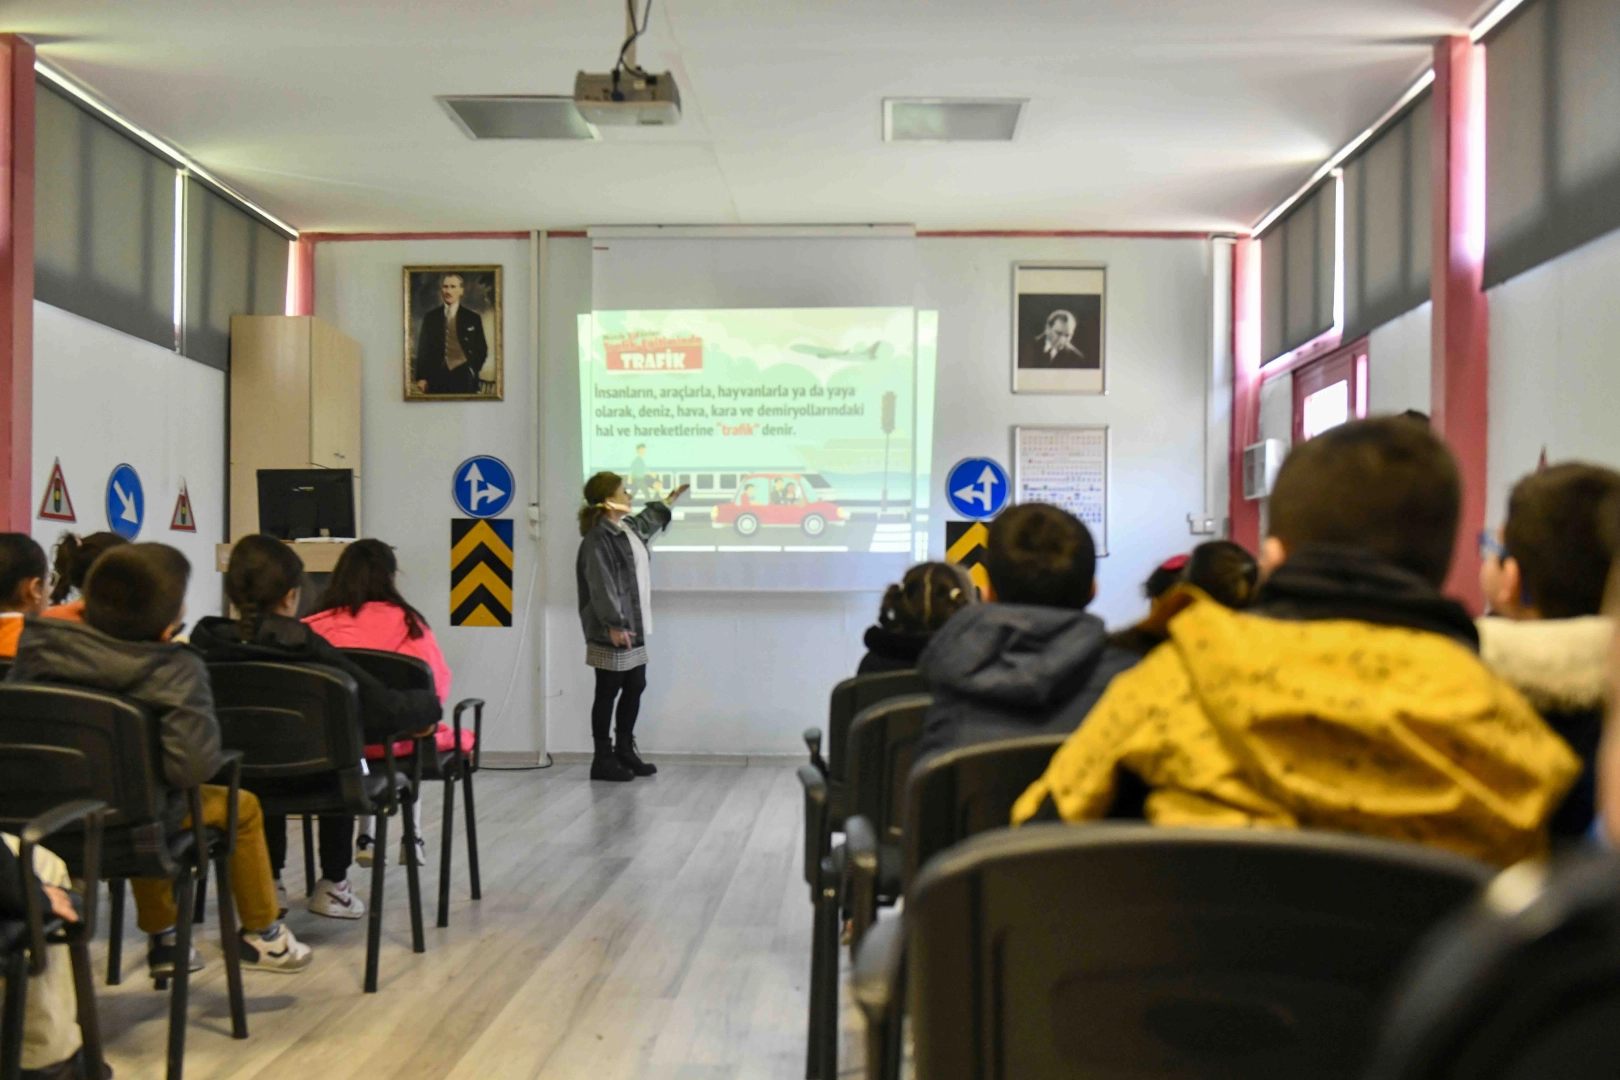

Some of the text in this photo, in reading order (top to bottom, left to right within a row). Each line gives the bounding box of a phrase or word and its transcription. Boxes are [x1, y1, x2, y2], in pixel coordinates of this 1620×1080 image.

[620, 348, 686, 369] TRAFİK
[594, 382, 856, 401] İnsanların, araçlarla, hayvanlarla ya da yaya
[595, 403, 865, 420] olarak, deniz, hava, kara ve demiryollarındaki
[595, 424, 614, 436] hal
[616, 426, 631, 436] ve
[634, 423, 714, 436] hareketlerine
[762, 422, 797, 436] denir.
